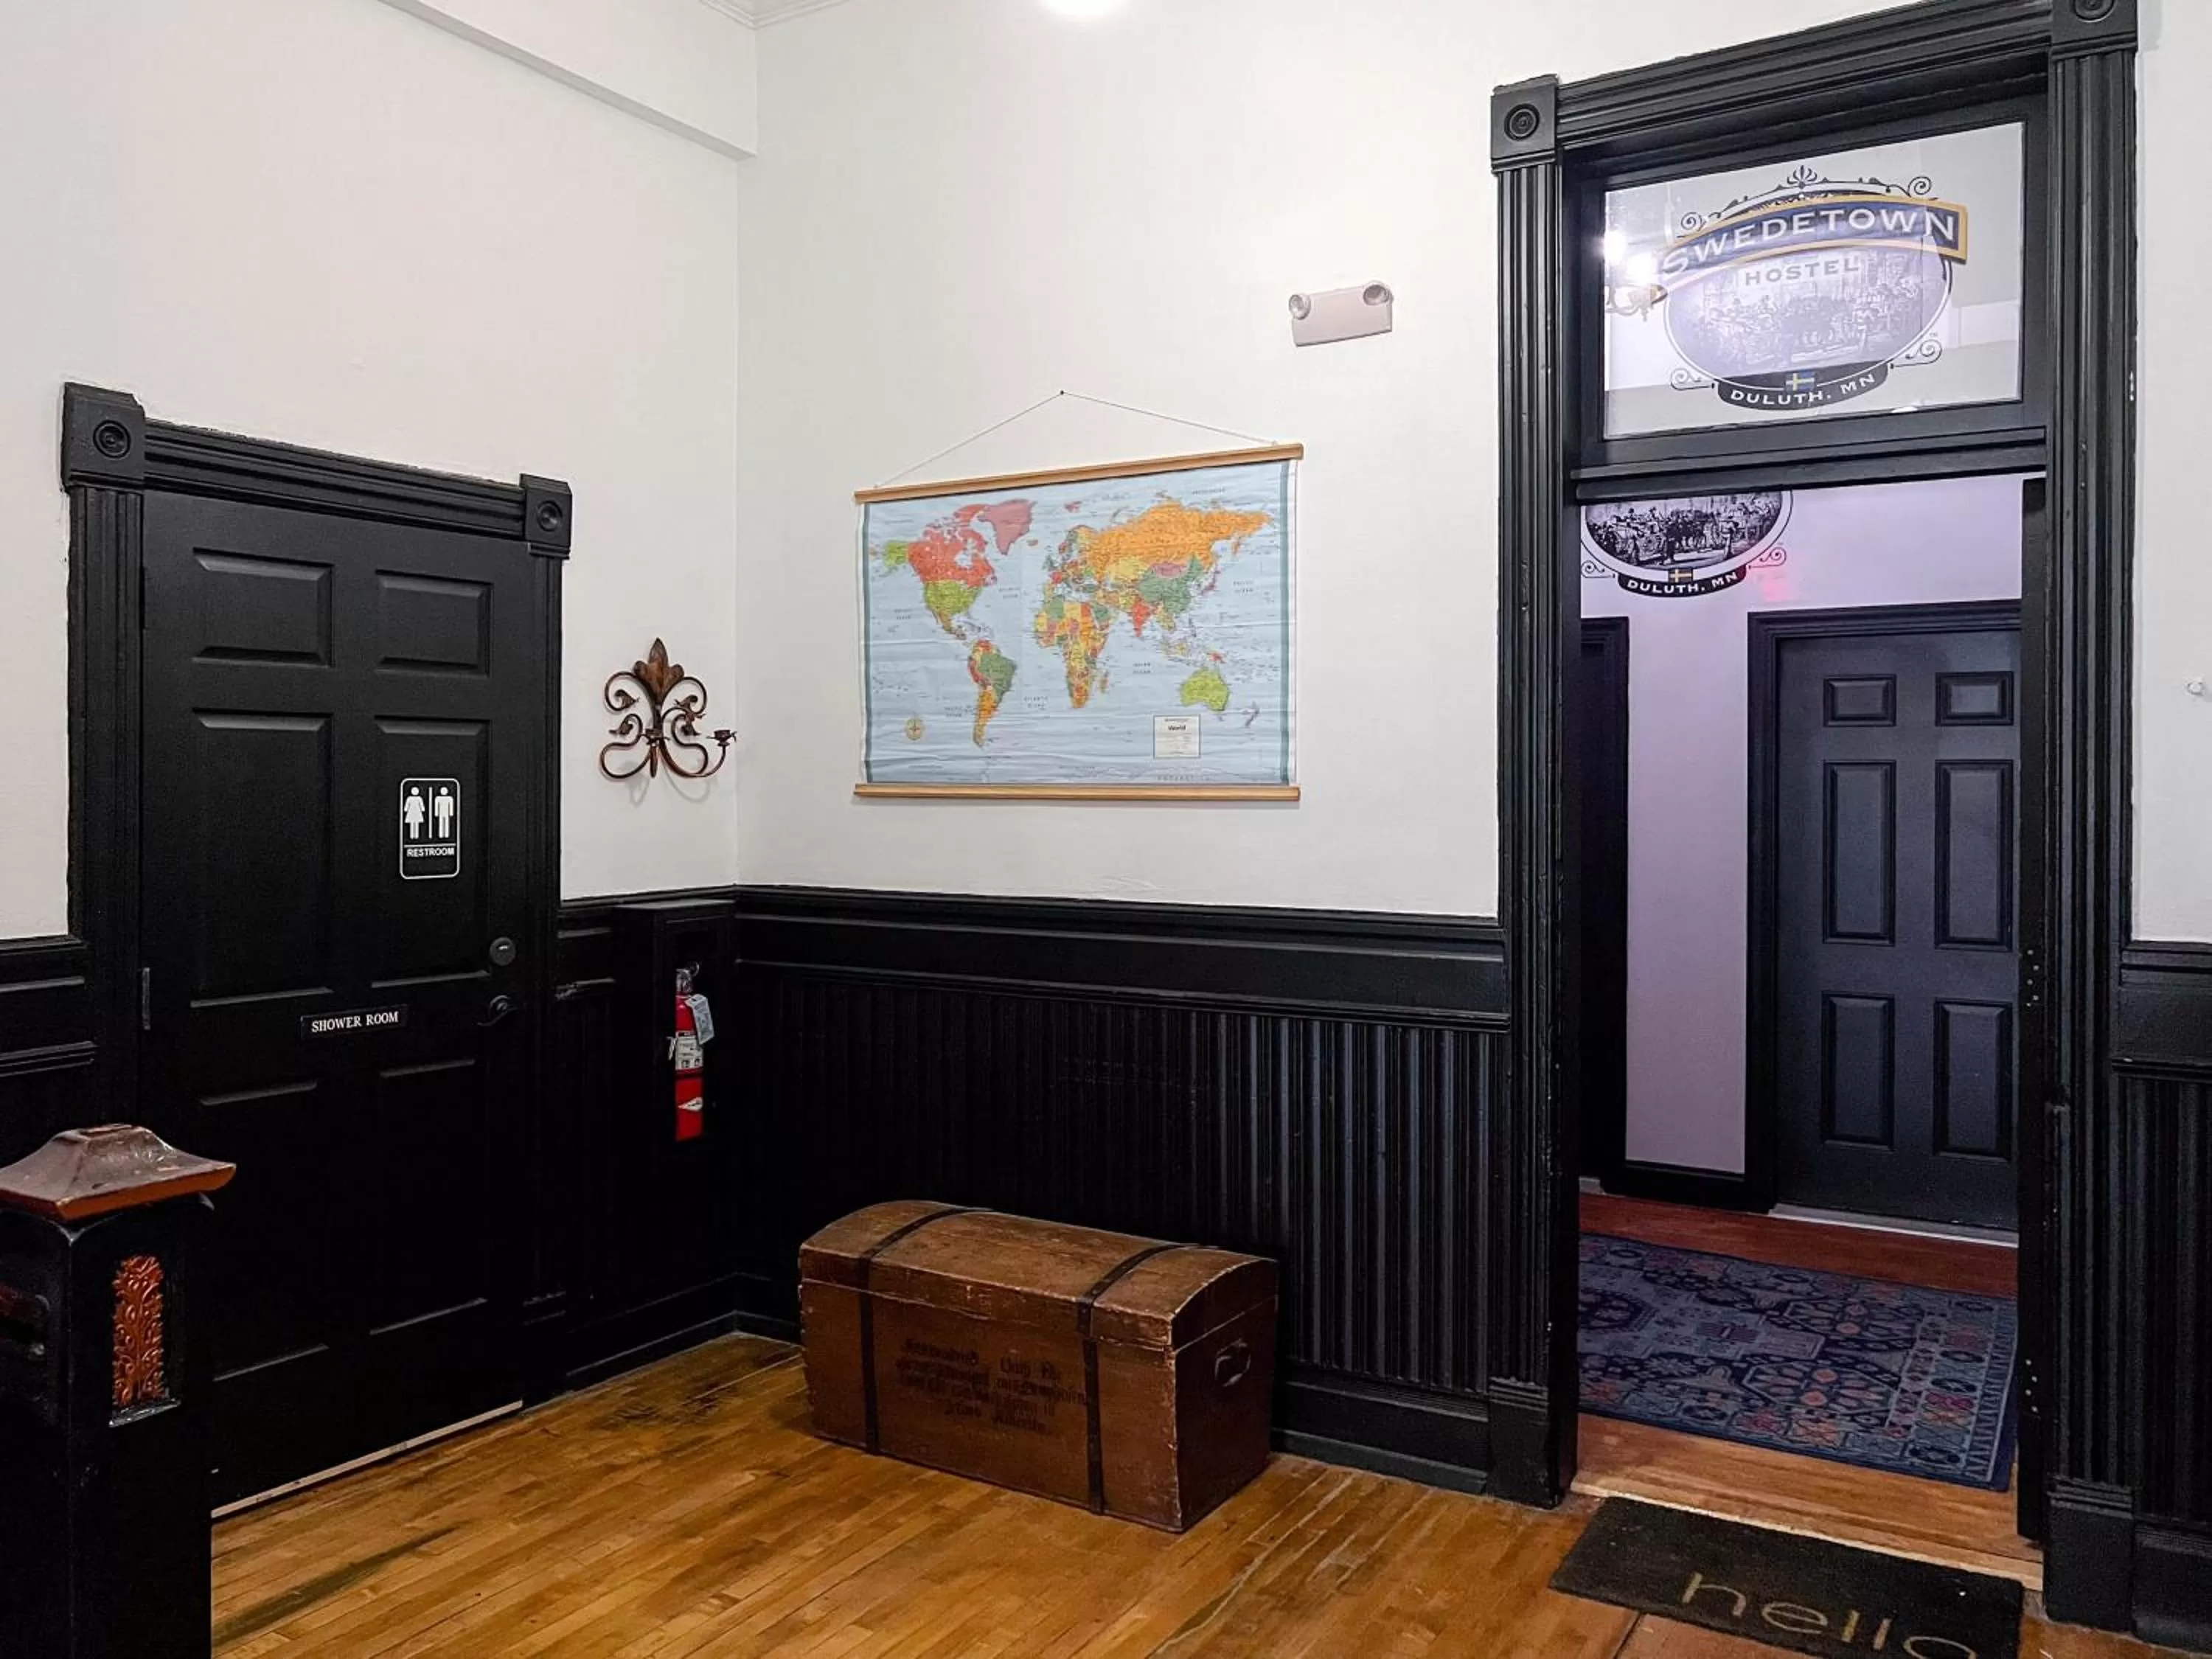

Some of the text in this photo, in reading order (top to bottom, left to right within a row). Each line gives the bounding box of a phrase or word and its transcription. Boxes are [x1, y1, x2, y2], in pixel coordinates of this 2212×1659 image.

[1660, 208, 1955, 276] SWEDETOWN
[1745, 259, 1860, 285] HOSTEL
[1839, 373, 1876, 394] MN
[1711, 572, 1737, 587] MN
[406, 847, 455, 858] RESTROOM
[311, 1012, 399, 1032] SHOWER ROOM
[1681, 1571, 1978, 1659] hello
